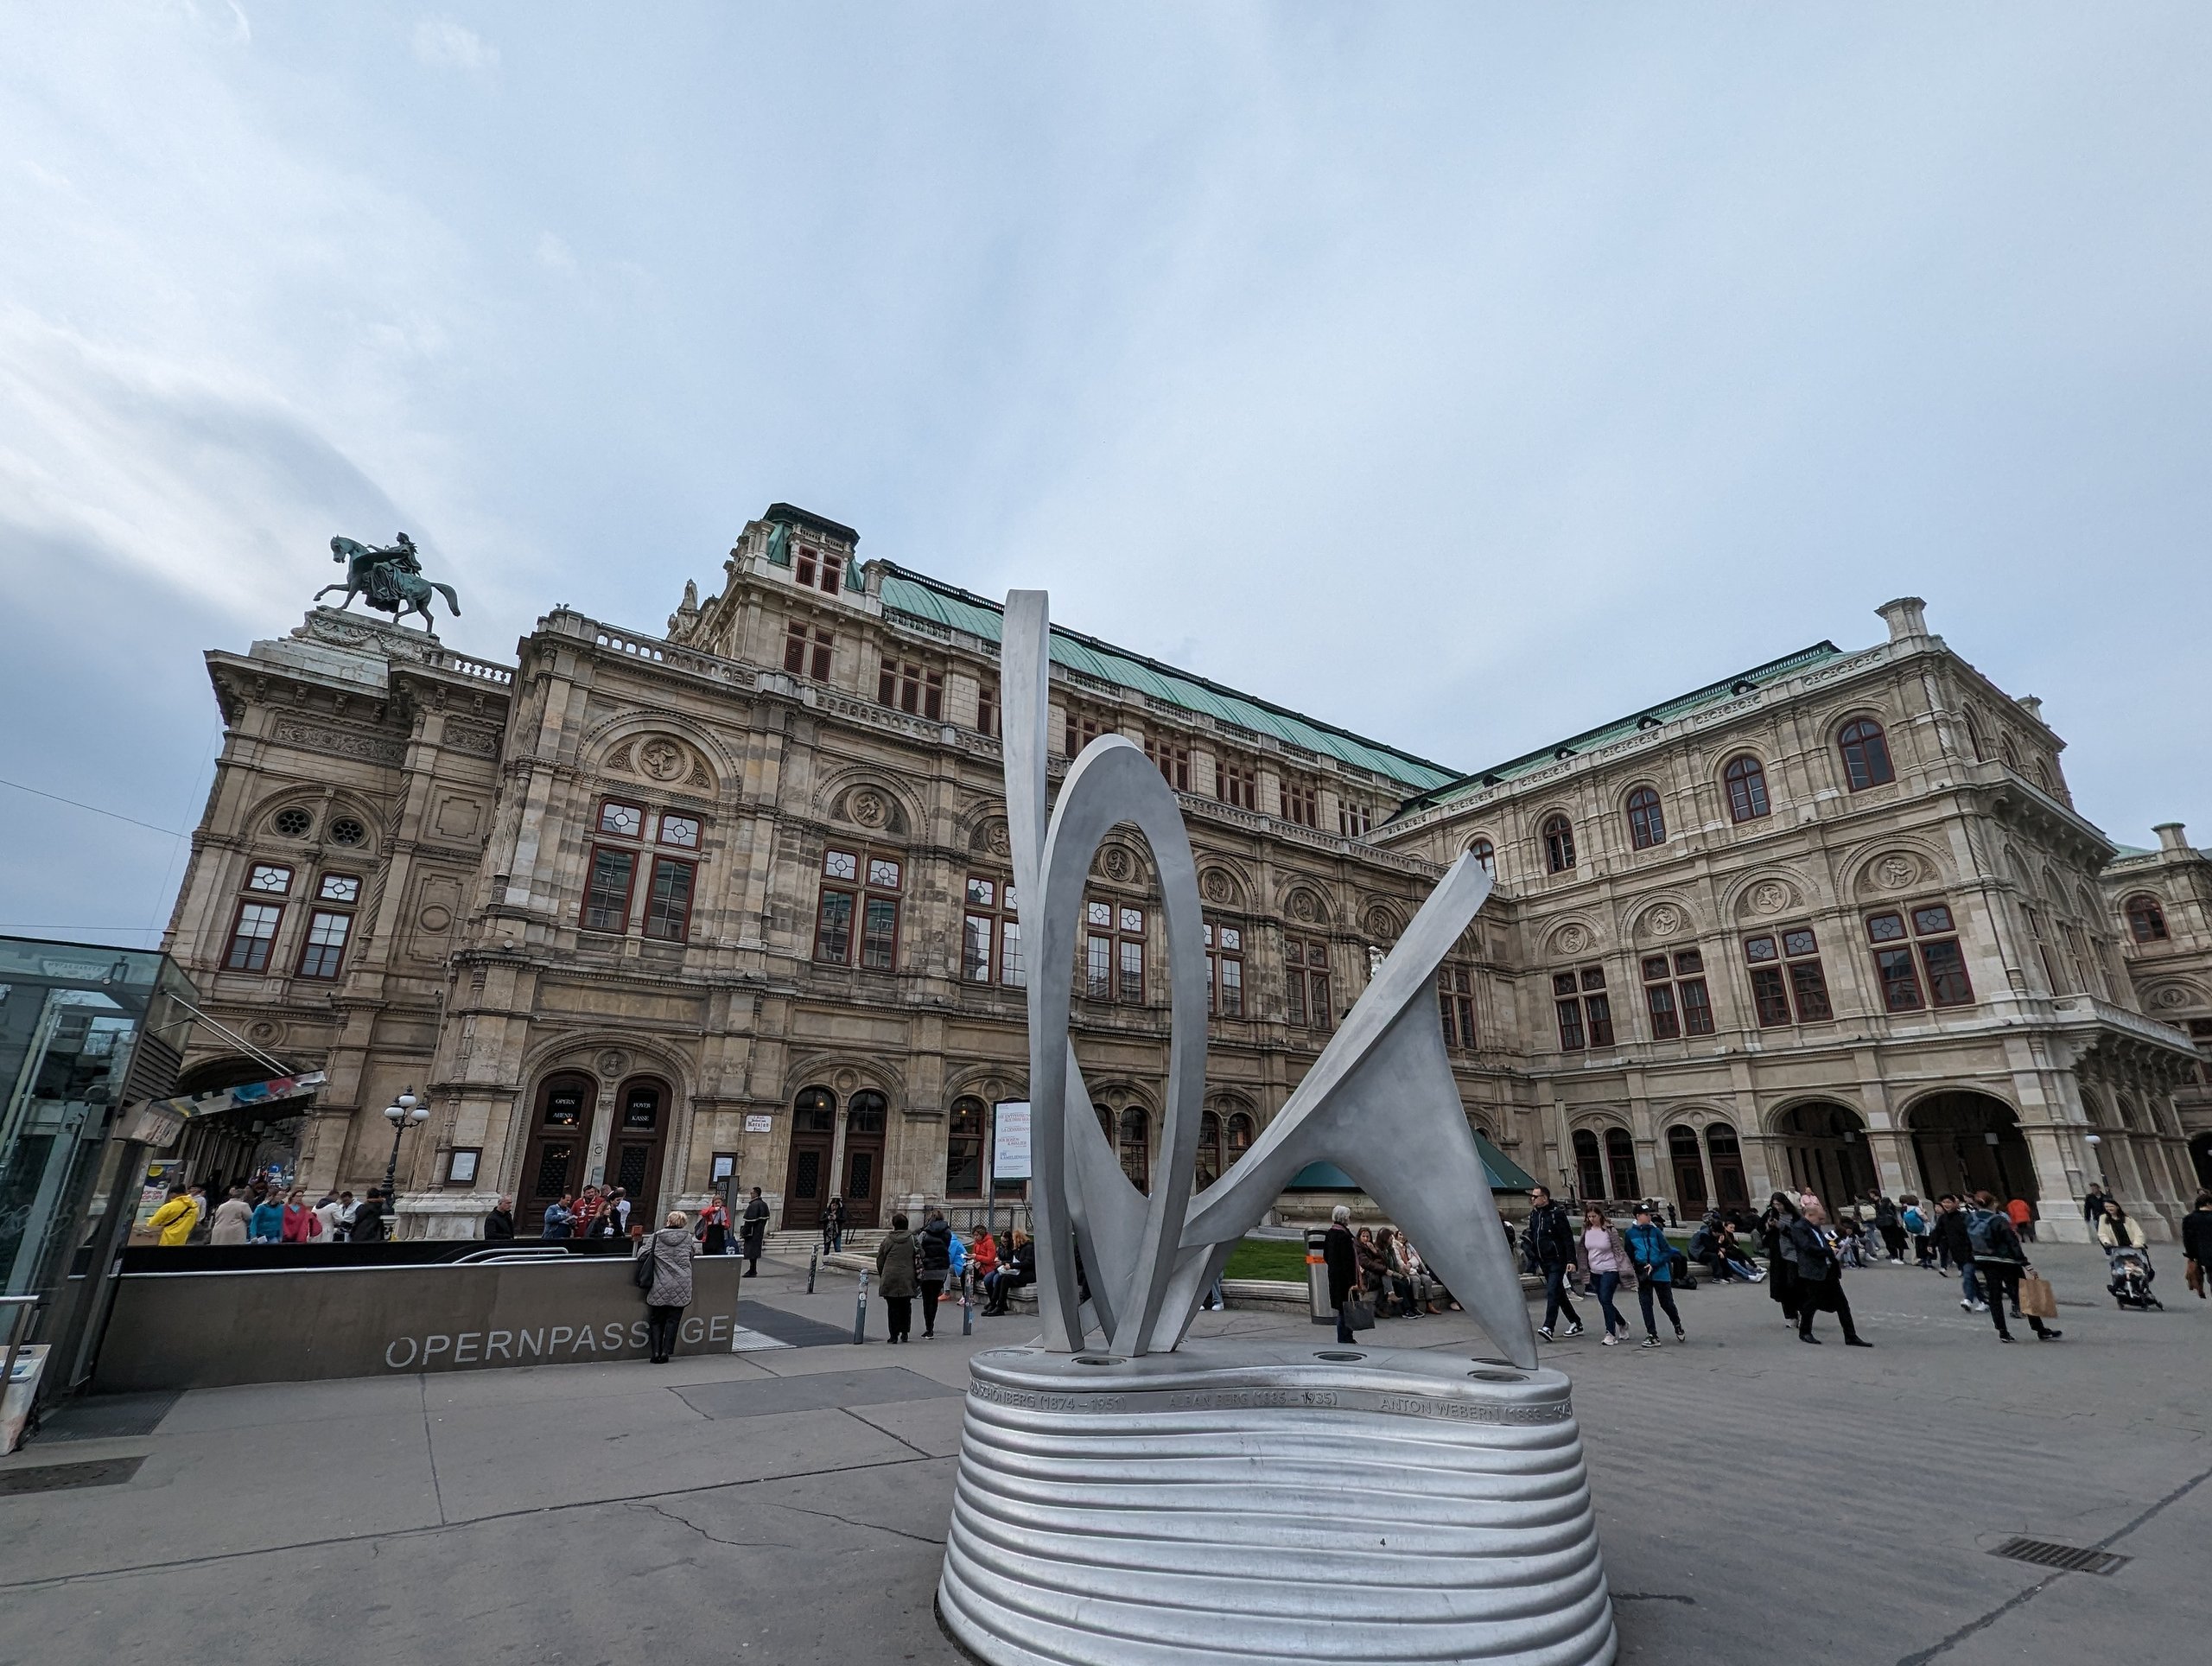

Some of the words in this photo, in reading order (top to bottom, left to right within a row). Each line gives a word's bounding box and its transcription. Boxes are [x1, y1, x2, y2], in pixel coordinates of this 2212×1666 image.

[385, 1314, 729, 1368] OPERNPASSGE
[981, 1384, 1036, 1408] SCHÖNBERG
[1040, 1395, 1075, 1410] (1874
[1216, 1392, 1249, 1406] BERG
[1380, 1396, 1432, 1415] ANTON
[1436, 1401, 1500, 1421] WEBERN
